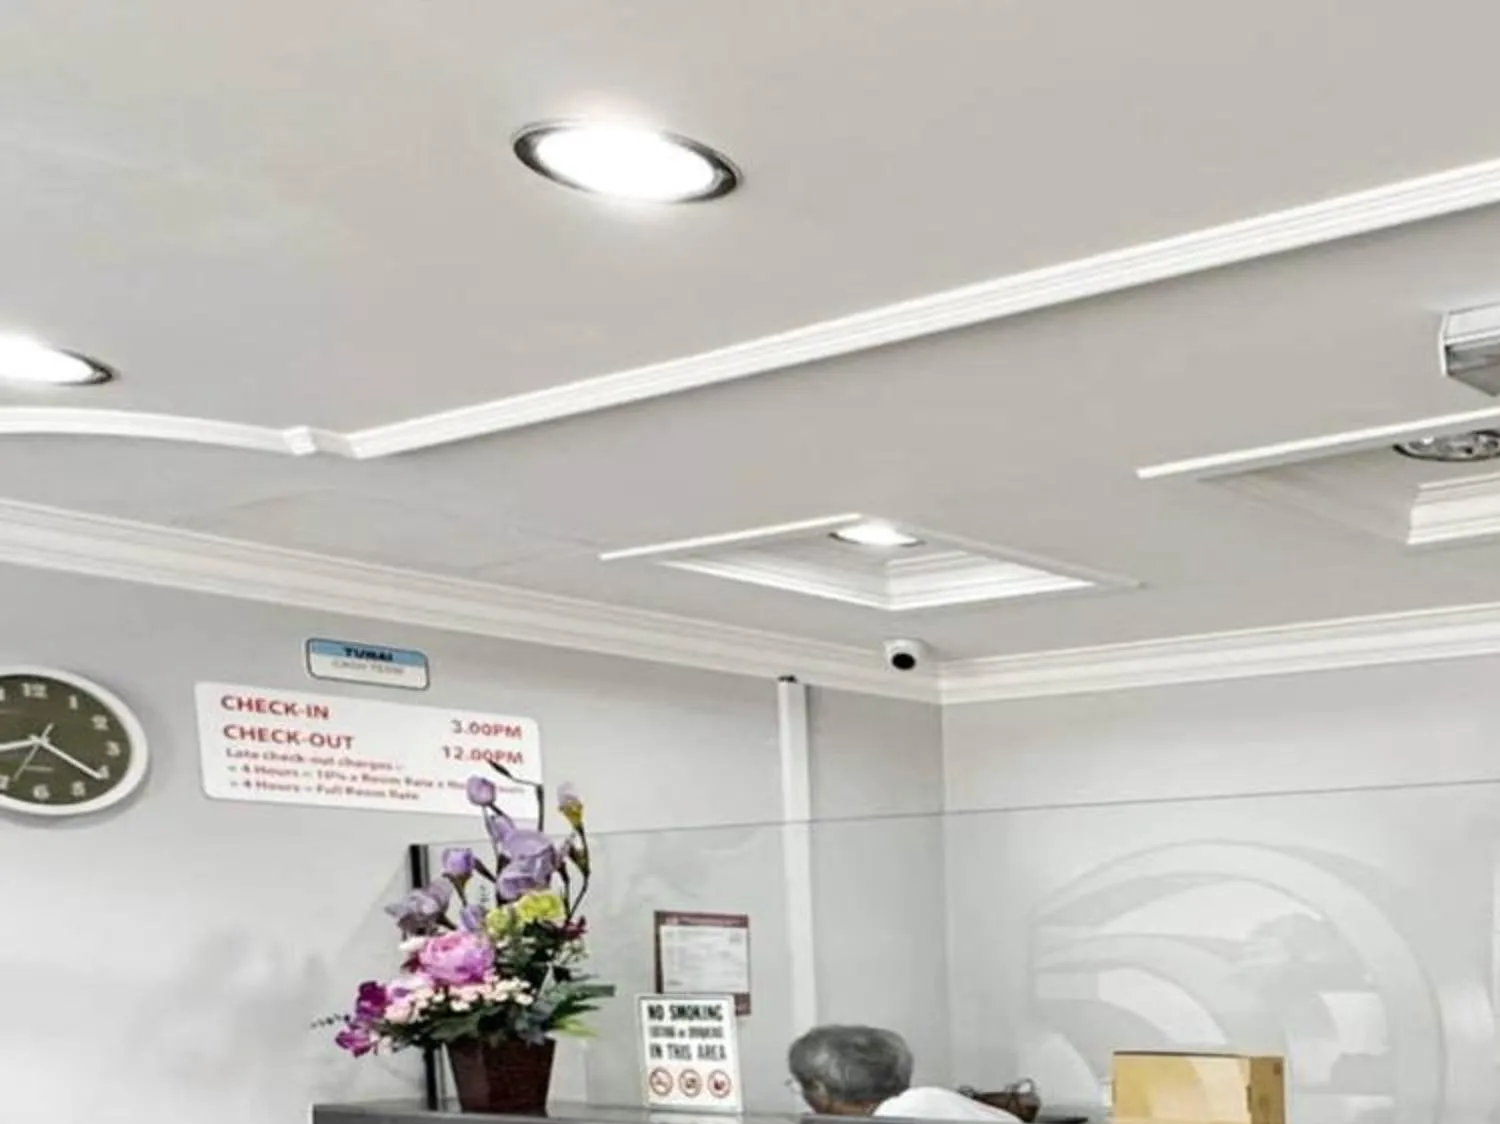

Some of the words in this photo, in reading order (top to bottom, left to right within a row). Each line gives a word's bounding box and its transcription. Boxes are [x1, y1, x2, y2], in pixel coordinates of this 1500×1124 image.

[221, 695, 329, 720] CHECK-IN
[223, 724, 355, 749] CHECK-OUT
[452, 720, 522, 740] 3.00PM
[442, 746, 524, 764] 12.00PM
[648, 1003, 664, 1021] NO
[669, 1004, 723, 1021] SMOKING
[650, 1043, 662, 1059] IN
[667, 1043, 692, 1060] THIS
[697, 1043, 727, 1061] AREA
